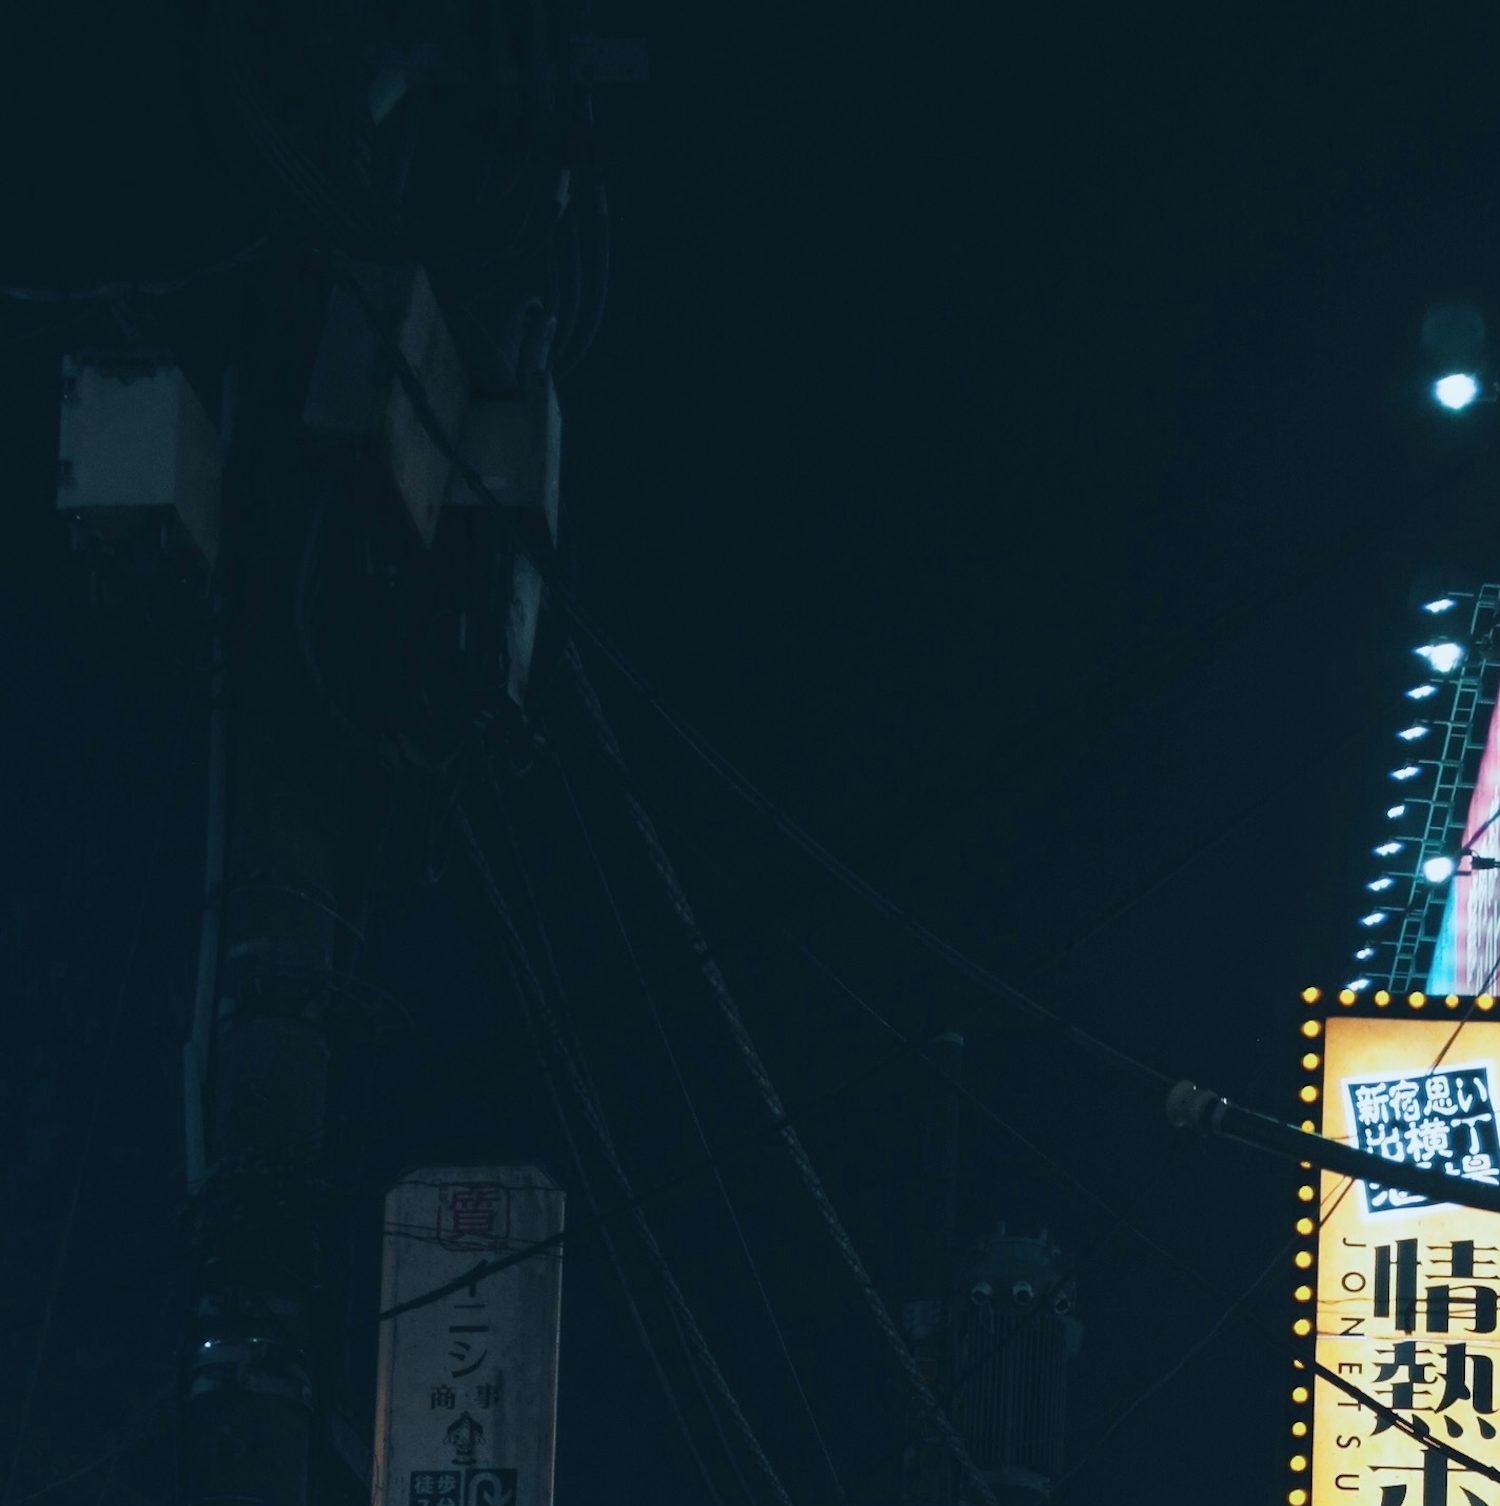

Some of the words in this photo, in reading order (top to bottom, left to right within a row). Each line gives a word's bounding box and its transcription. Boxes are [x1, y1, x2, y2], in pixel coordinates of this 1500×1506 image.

[1355, 1075, 1488, 1126] 新宿思い
[1365, 1113, 1492, 1163] 出横丁
[452, 1186, 499, 1241] 質
[1335, 1238, 1366, 1491] JONETSU
[414, 1475, 456, 1495] 徒歩
